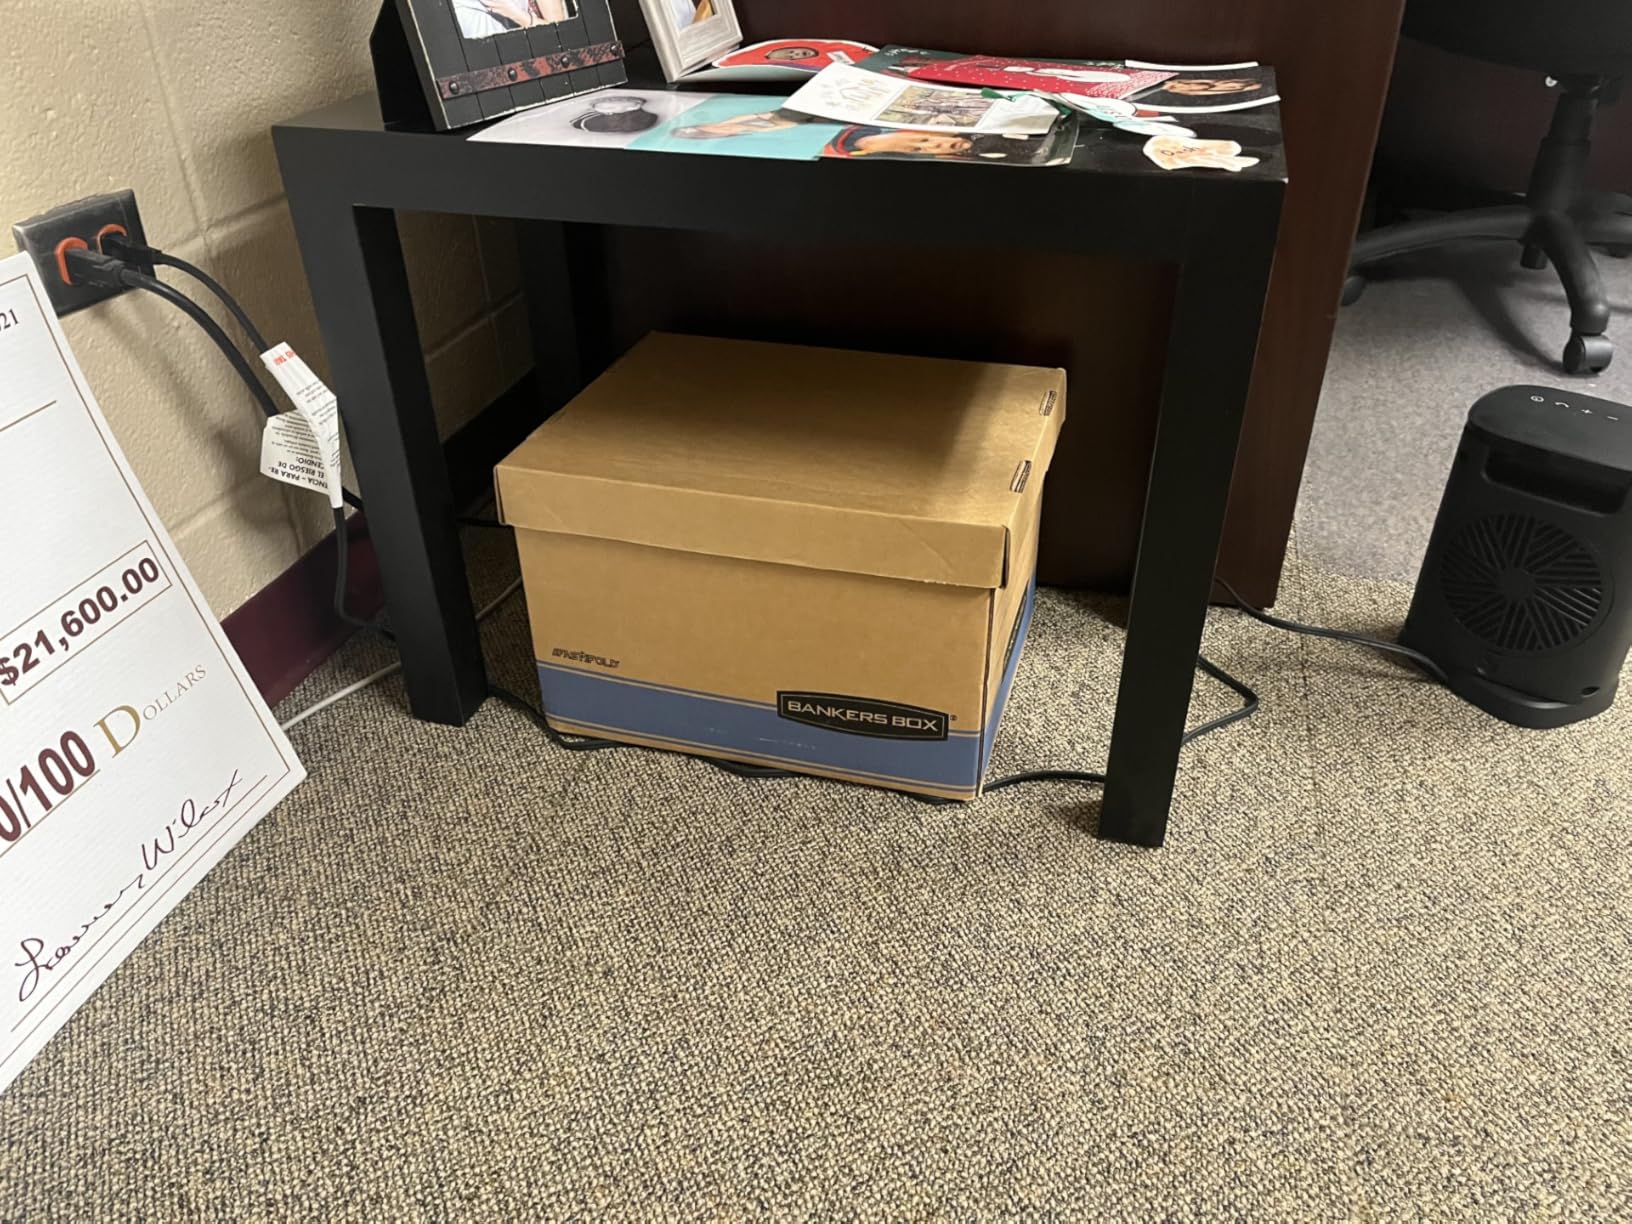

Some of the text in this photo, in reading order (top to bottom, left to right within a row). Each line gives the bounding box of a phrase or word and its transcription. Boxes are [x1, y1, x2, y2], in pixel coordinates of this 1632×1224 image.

[281, 470, 300, 481] PARA
[289, 464, 316, 477] RIESGO
[0, 557, 159, 686] $21,600.00
[787, 700, 939, 732] BANKERS BOX
